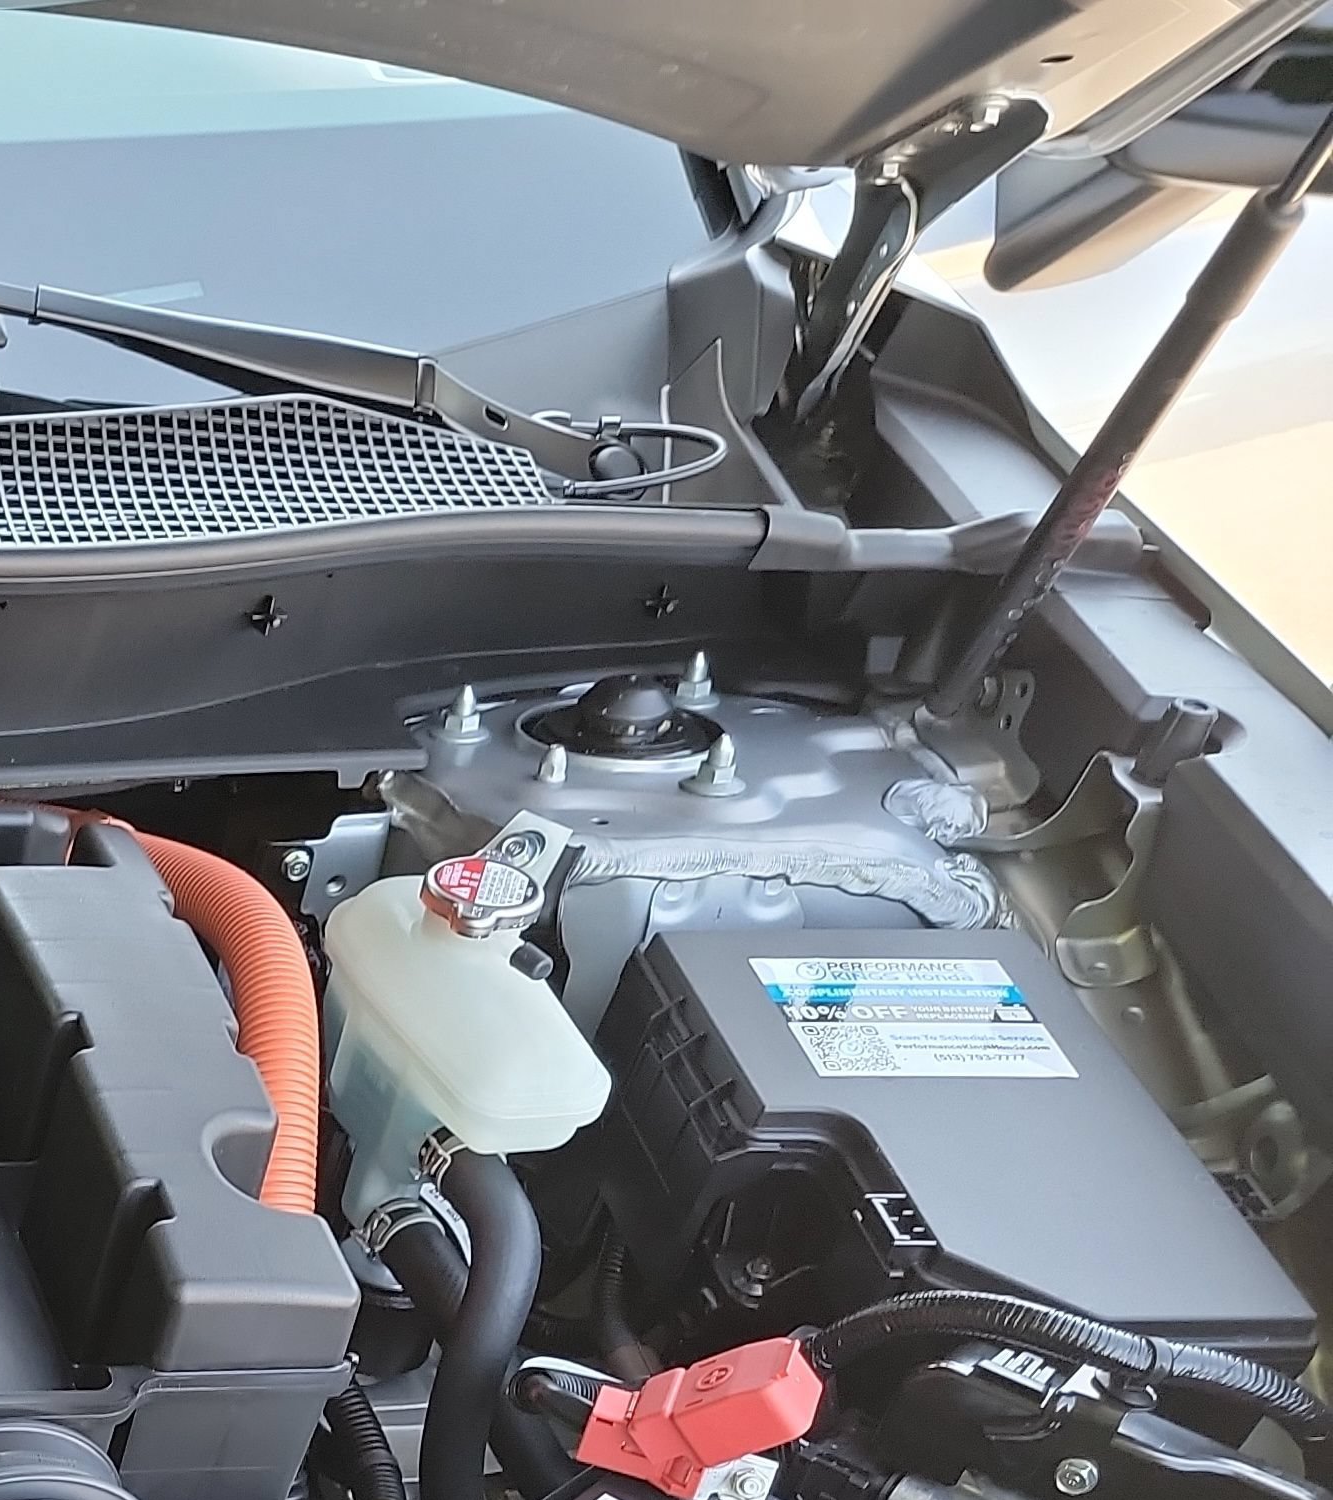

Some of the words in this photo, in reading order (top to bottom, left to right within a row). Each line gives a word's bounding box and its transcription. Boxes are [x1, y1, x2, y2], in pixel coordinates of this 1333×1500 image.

[827, 962, 965, 971] PERFORMANCE
[832, 971, 899, 982] KINGS
[912, 972, 974, 982] Honda
[783, 988, 906, 998] COMPLIMENTARY
[908, 988, 1009, 998] INSTALLATION
[787, 1005, 846, 1020] 10%
[851, 1005, 908, 1020] OFF
[933, 1053, 966, 1062] (513)
